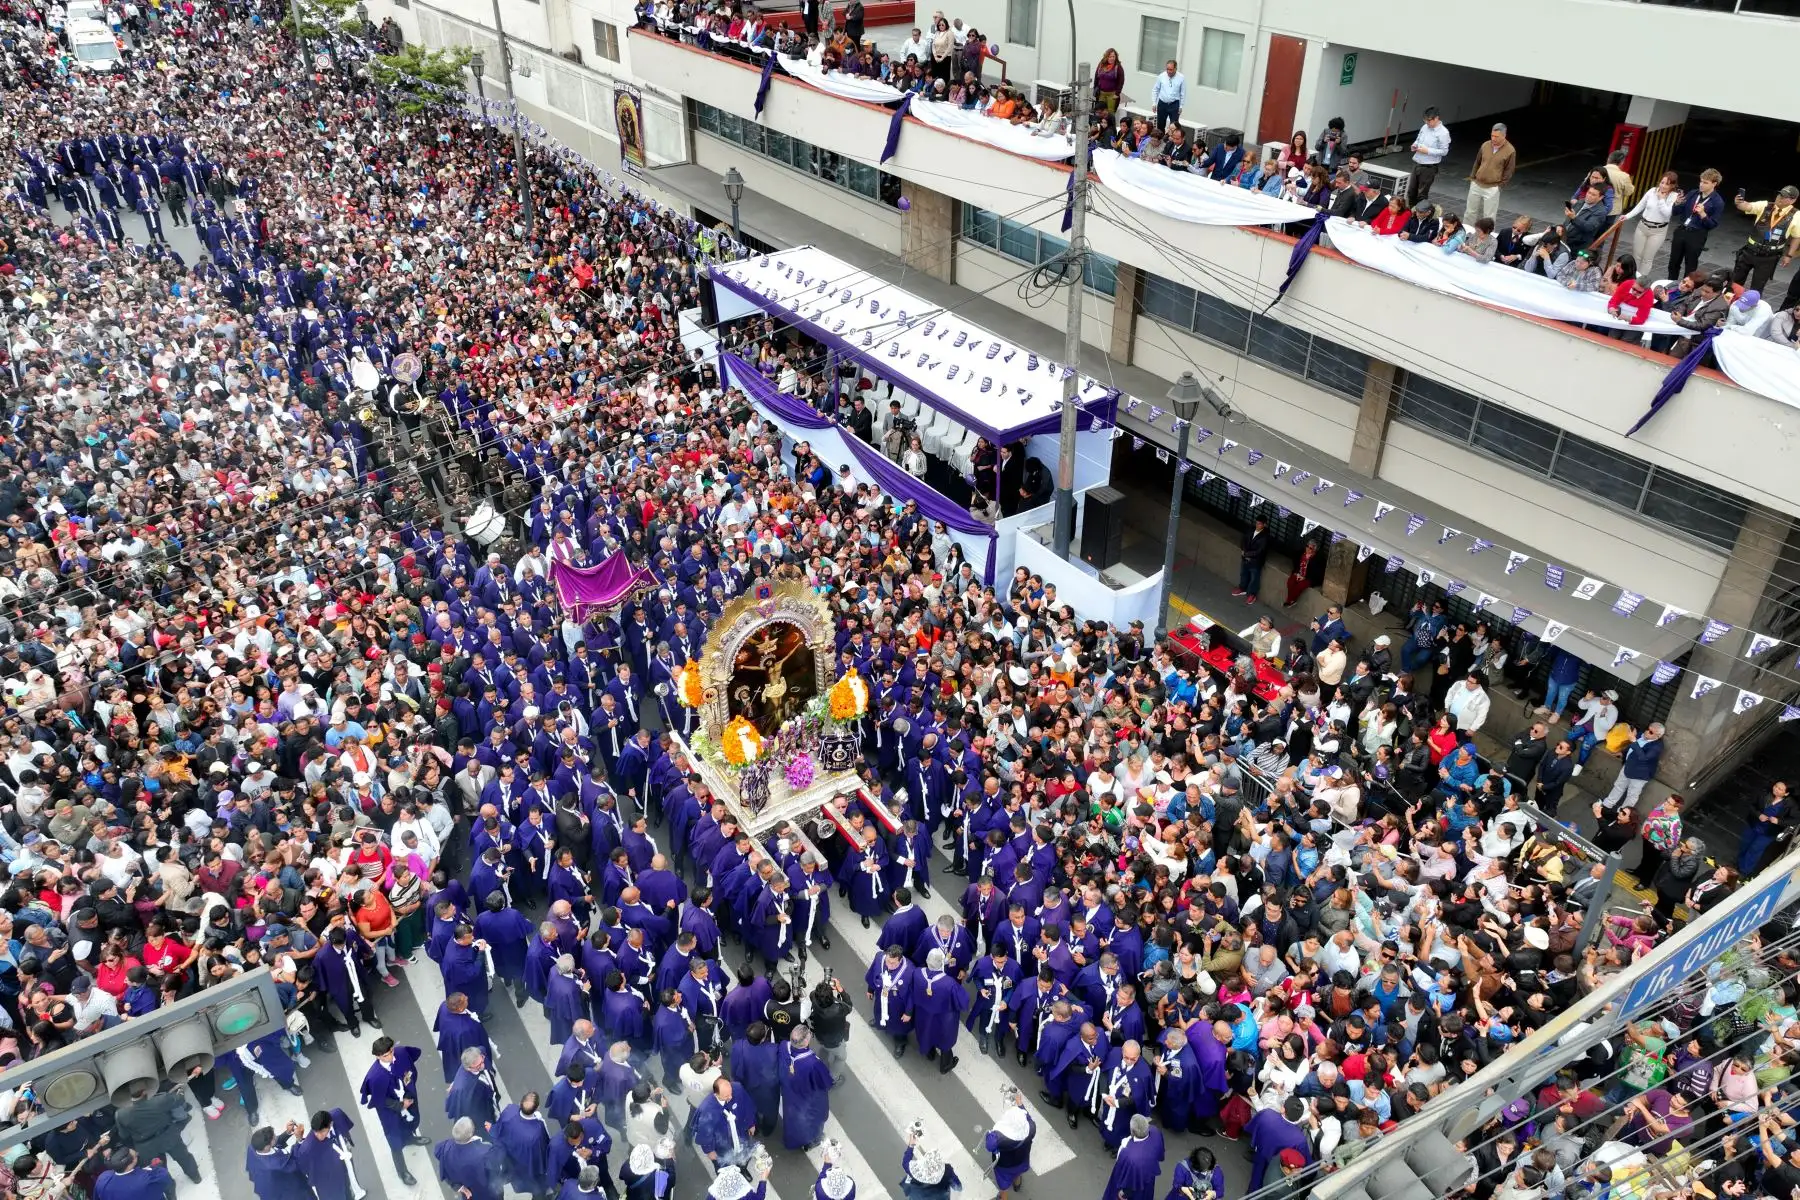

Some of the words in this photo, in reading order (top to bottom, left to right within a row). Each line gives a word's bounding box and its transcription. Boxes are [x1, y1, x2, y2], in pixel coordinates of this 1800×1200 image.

[1558, 831, 1582, 848] Alfonso
[1582, 845, 1603, 862] Ugarte
[1634, 964, 1674, 1008] JR.
[1682, 894, 1771, 973] QUILCA
